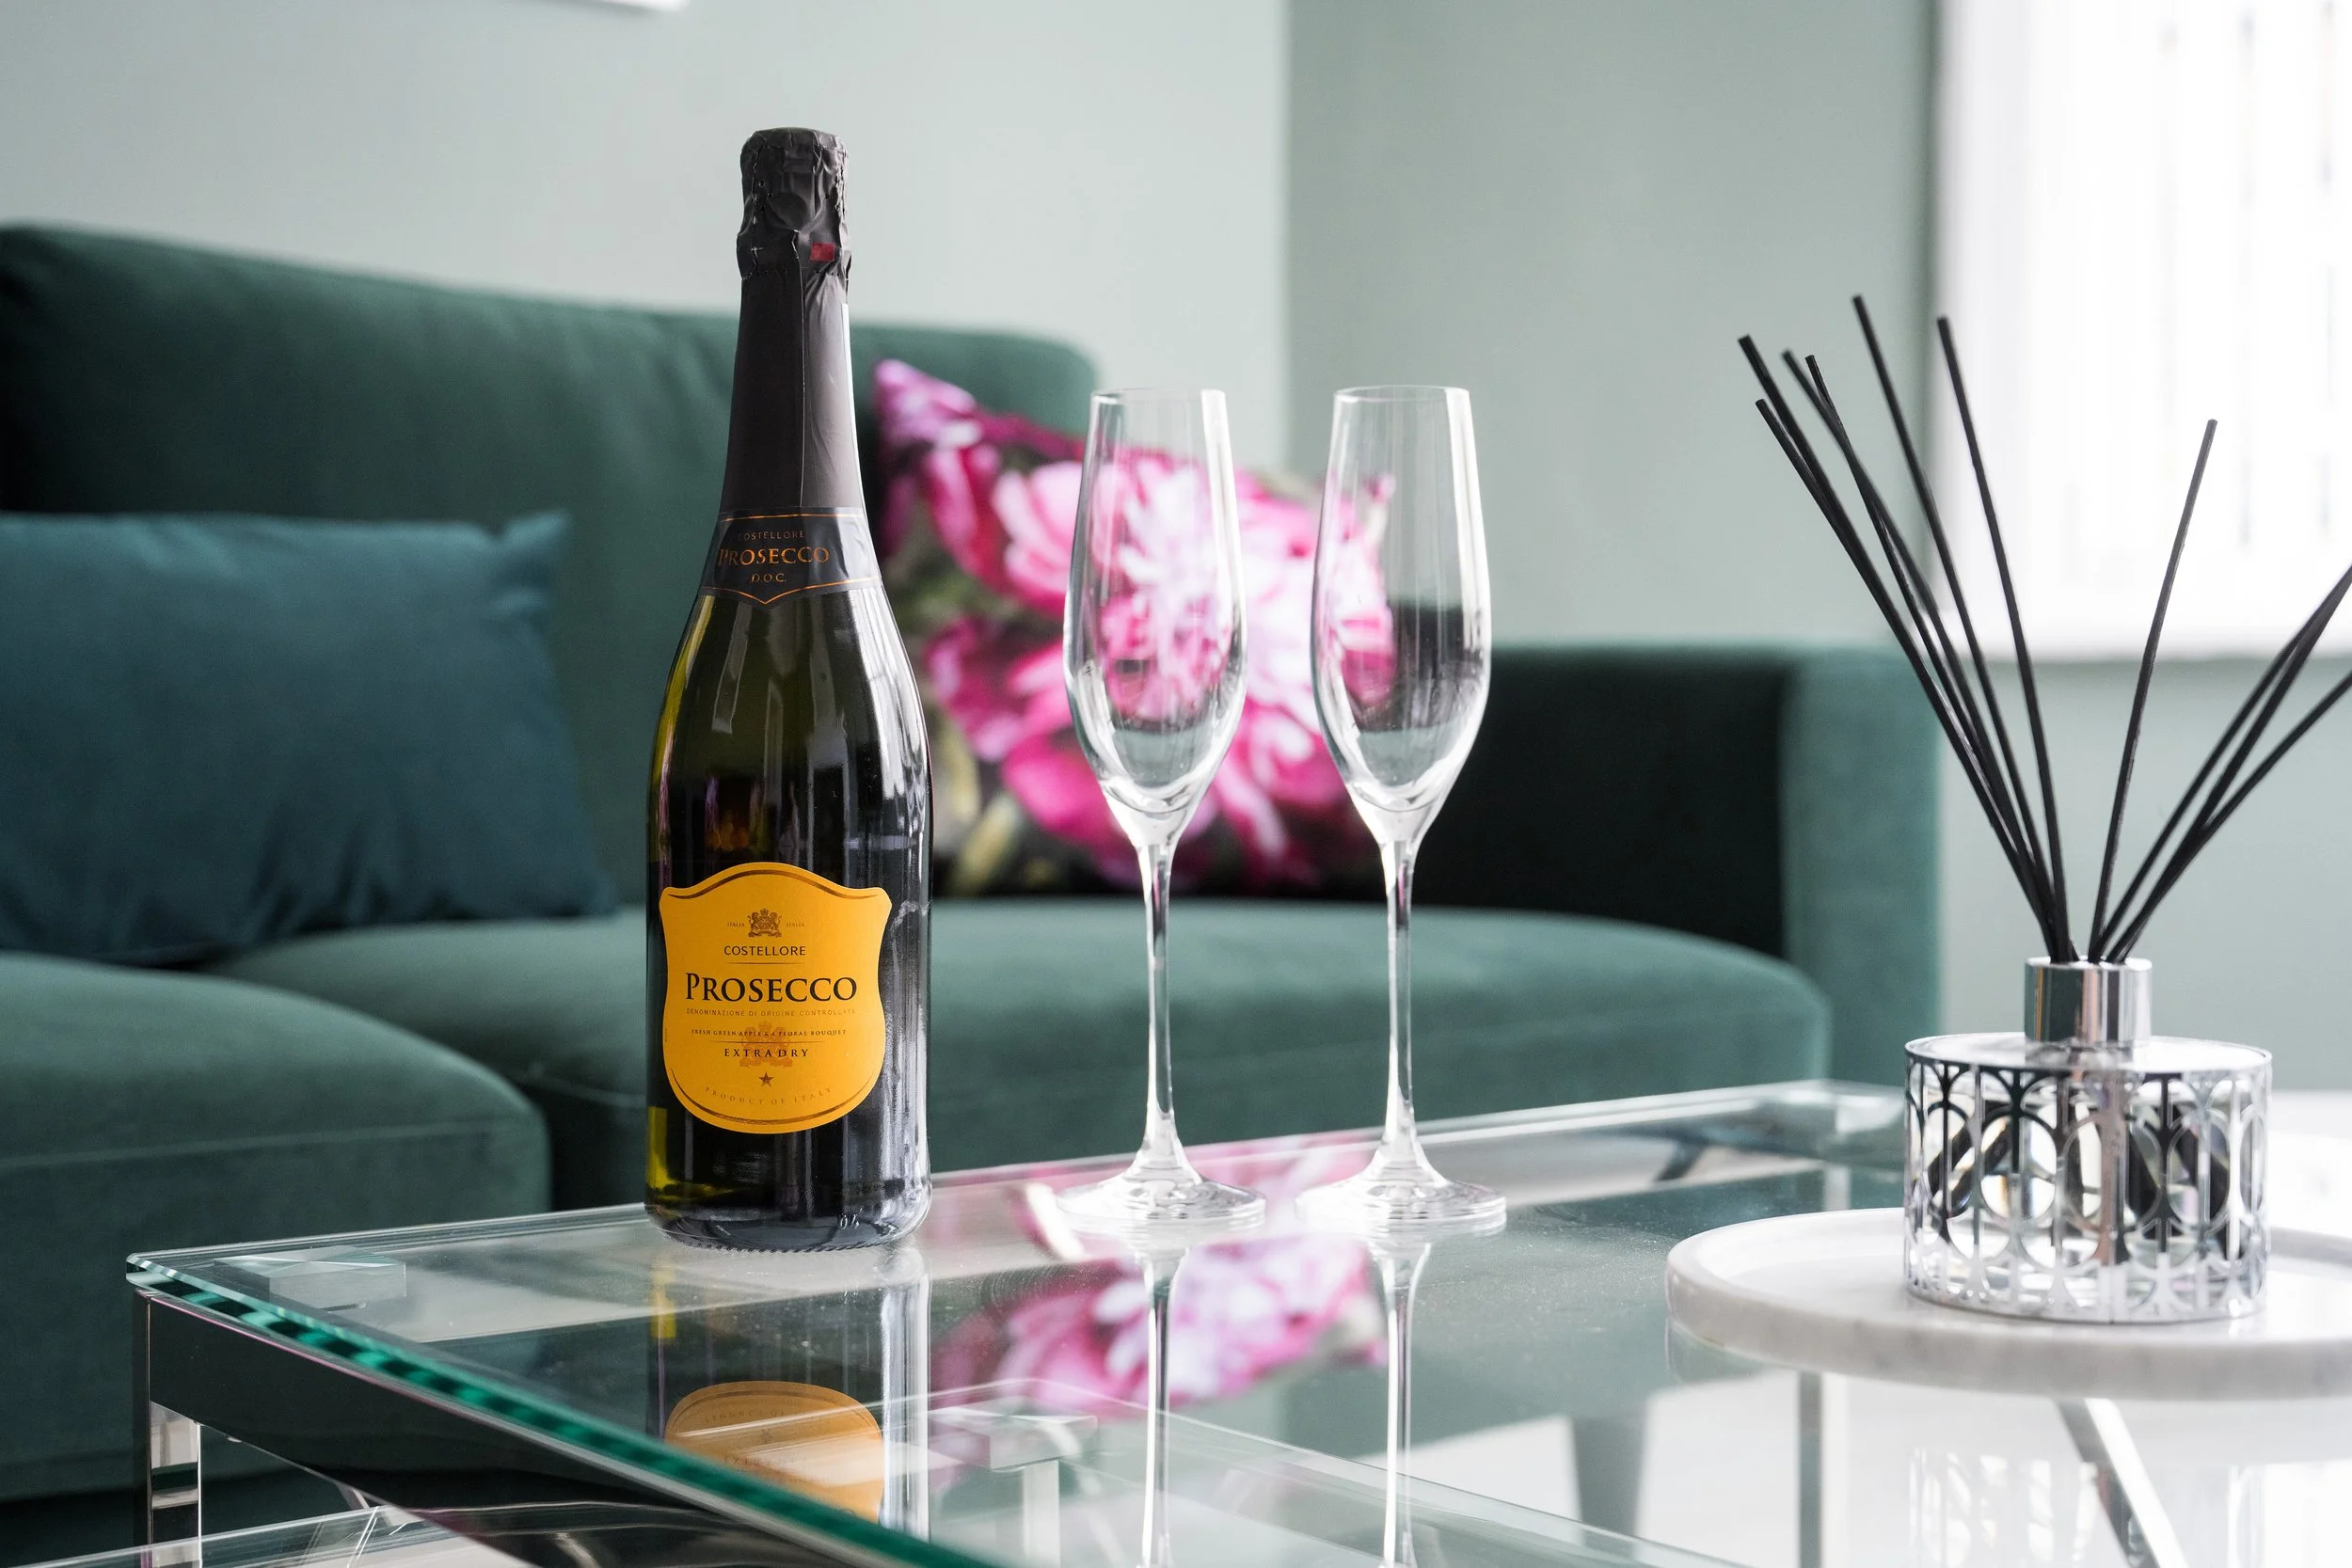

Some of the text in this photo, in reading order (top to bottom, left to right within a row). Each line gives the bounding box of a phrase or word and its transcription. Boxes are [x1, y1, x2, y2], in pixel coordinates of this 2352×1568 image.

[738, 530, 805, 542] COSTELLORE
[718, 546, 830, 567] PROSECCO
[723, 945, 806, 957] COSTELLORE
[685, 972, 858, 1003] PROSECCO
[686, 1007, 745, 1017] DENOMINAZIONE
[799, 1008, 856, 1017] CONTROLLATA
[723, 1048, 809, 1058] EXTRA DRY
[705, 1085, 832, 1105] PRODUCT OF ITALY
